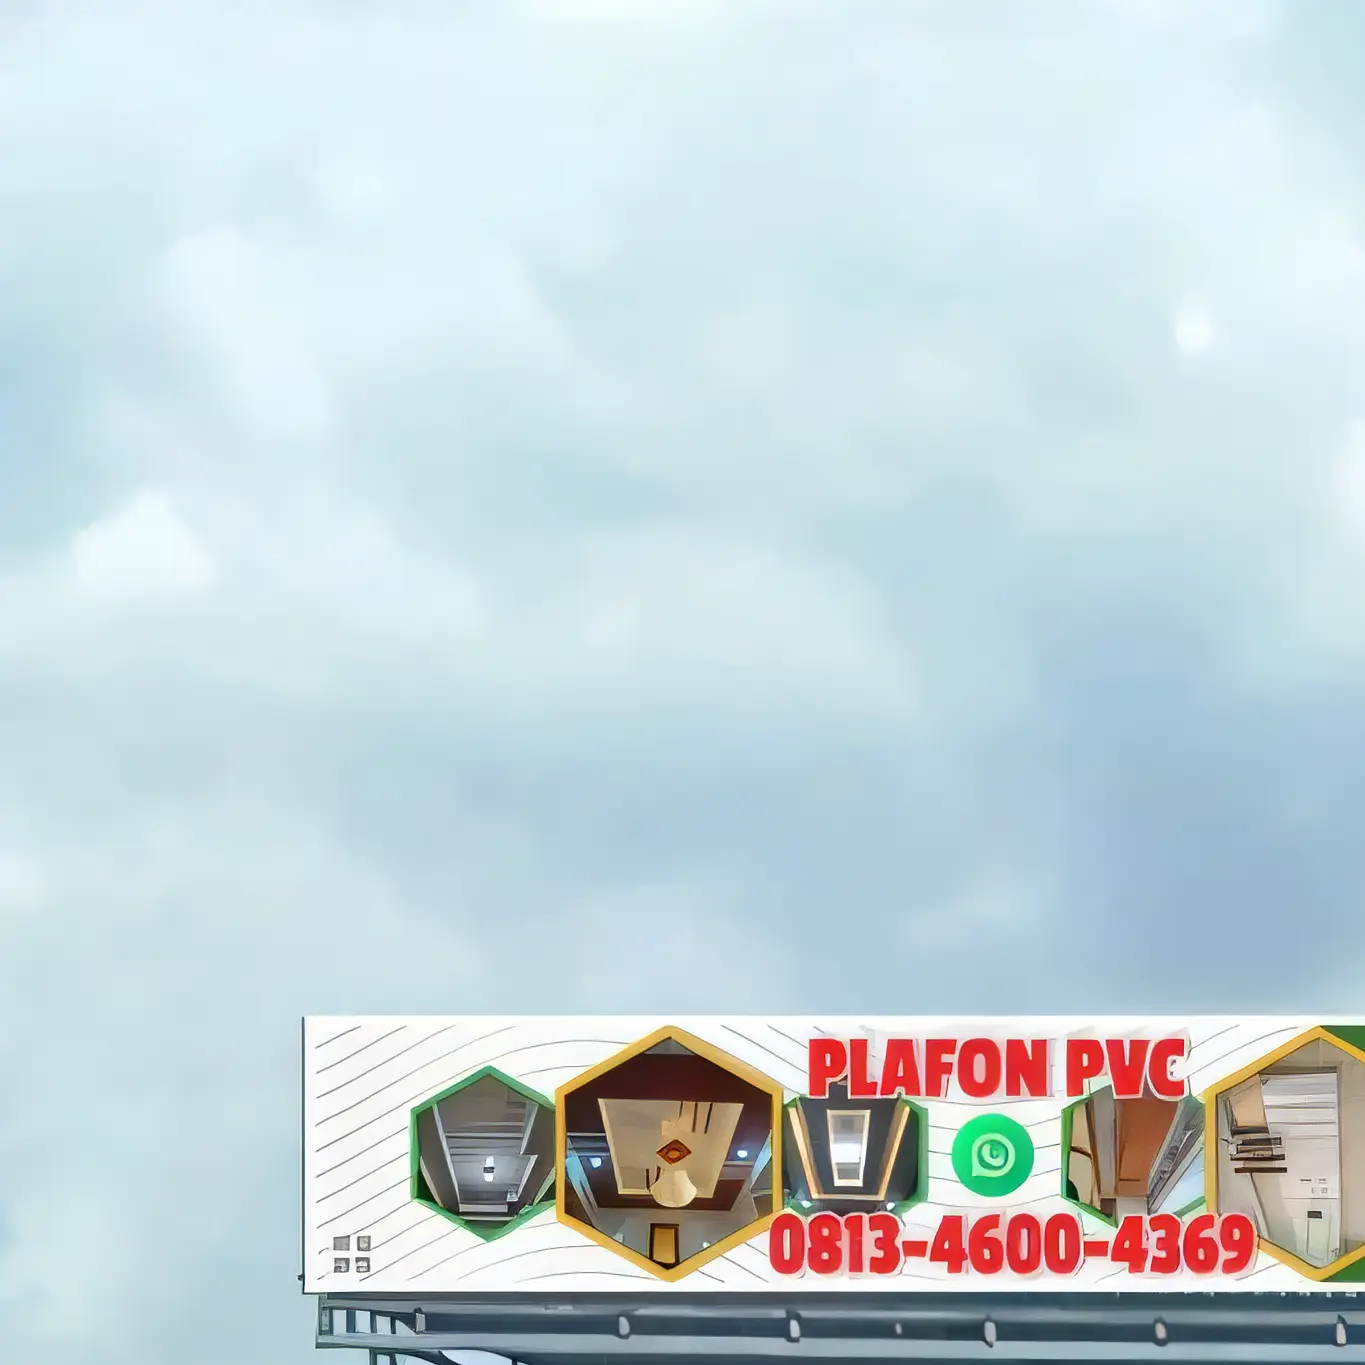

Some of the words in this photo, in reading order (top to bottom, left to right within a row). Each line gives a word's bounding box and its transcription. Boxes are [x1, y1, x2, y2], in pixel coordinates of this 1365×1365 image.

[808, 1038, 1049, 1097] PLAFON
[1066, 1038, 1186, 1097] PVC
[769, 1213, 1256, 1275] 0813-4600-4369
